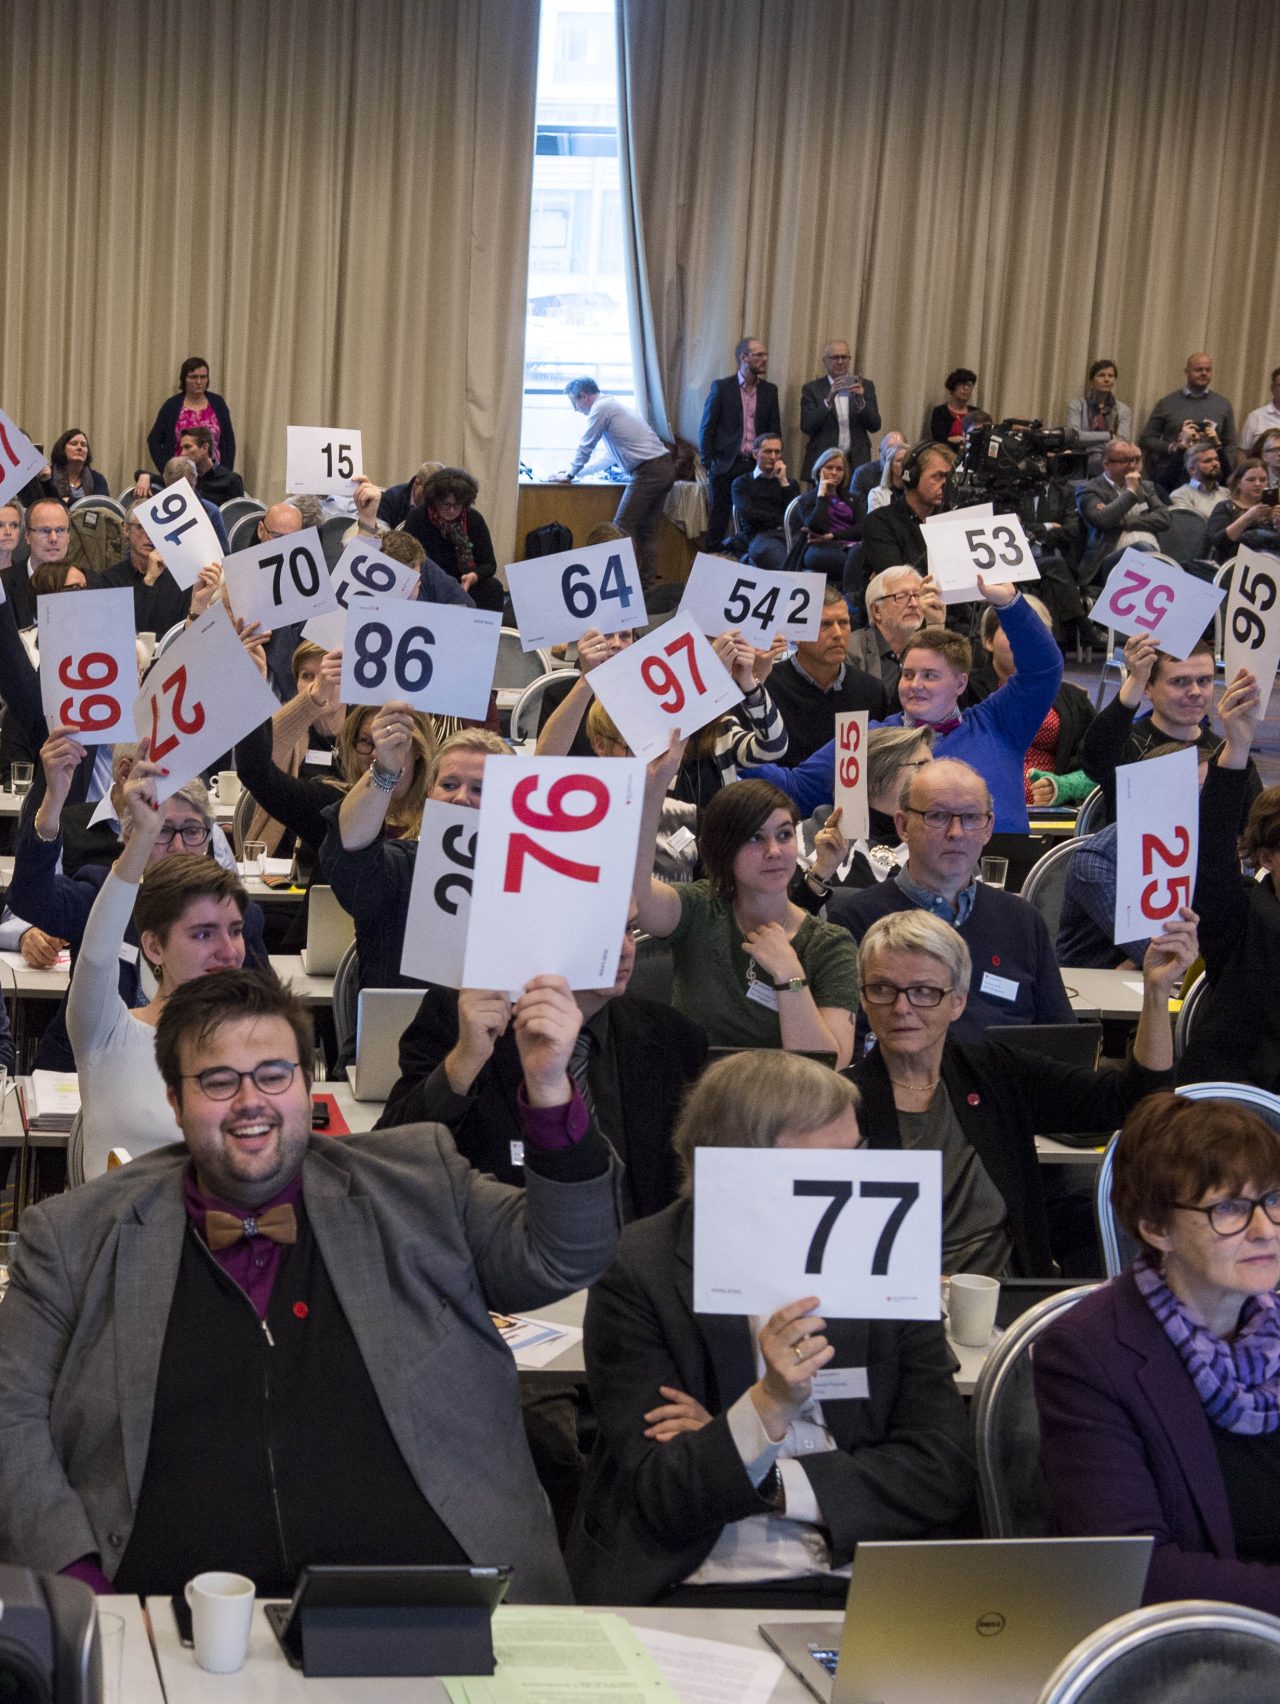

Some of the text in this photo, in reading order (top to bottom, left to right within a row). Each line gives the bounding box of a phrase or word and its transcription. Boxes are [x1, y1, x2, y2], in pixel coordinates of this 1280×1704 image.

[321, 443, 354, 479] 15
[258, 546, 320, 607] 70
[965, 525, 1024, 571] 53
[561, 554, 632, 619] 64
[723, 578, 779, 631] 54
[1110, 571, 1174, 628] 52
[1230, 563, 1278, 651] 95
[640, 633, 707, 714] 97
[839, 725, 861, 789] 65
[503, 773, 611, 894] 76
[1140, 826, 1190, 920] 25
[793, 1179, 919, 1276] 77
